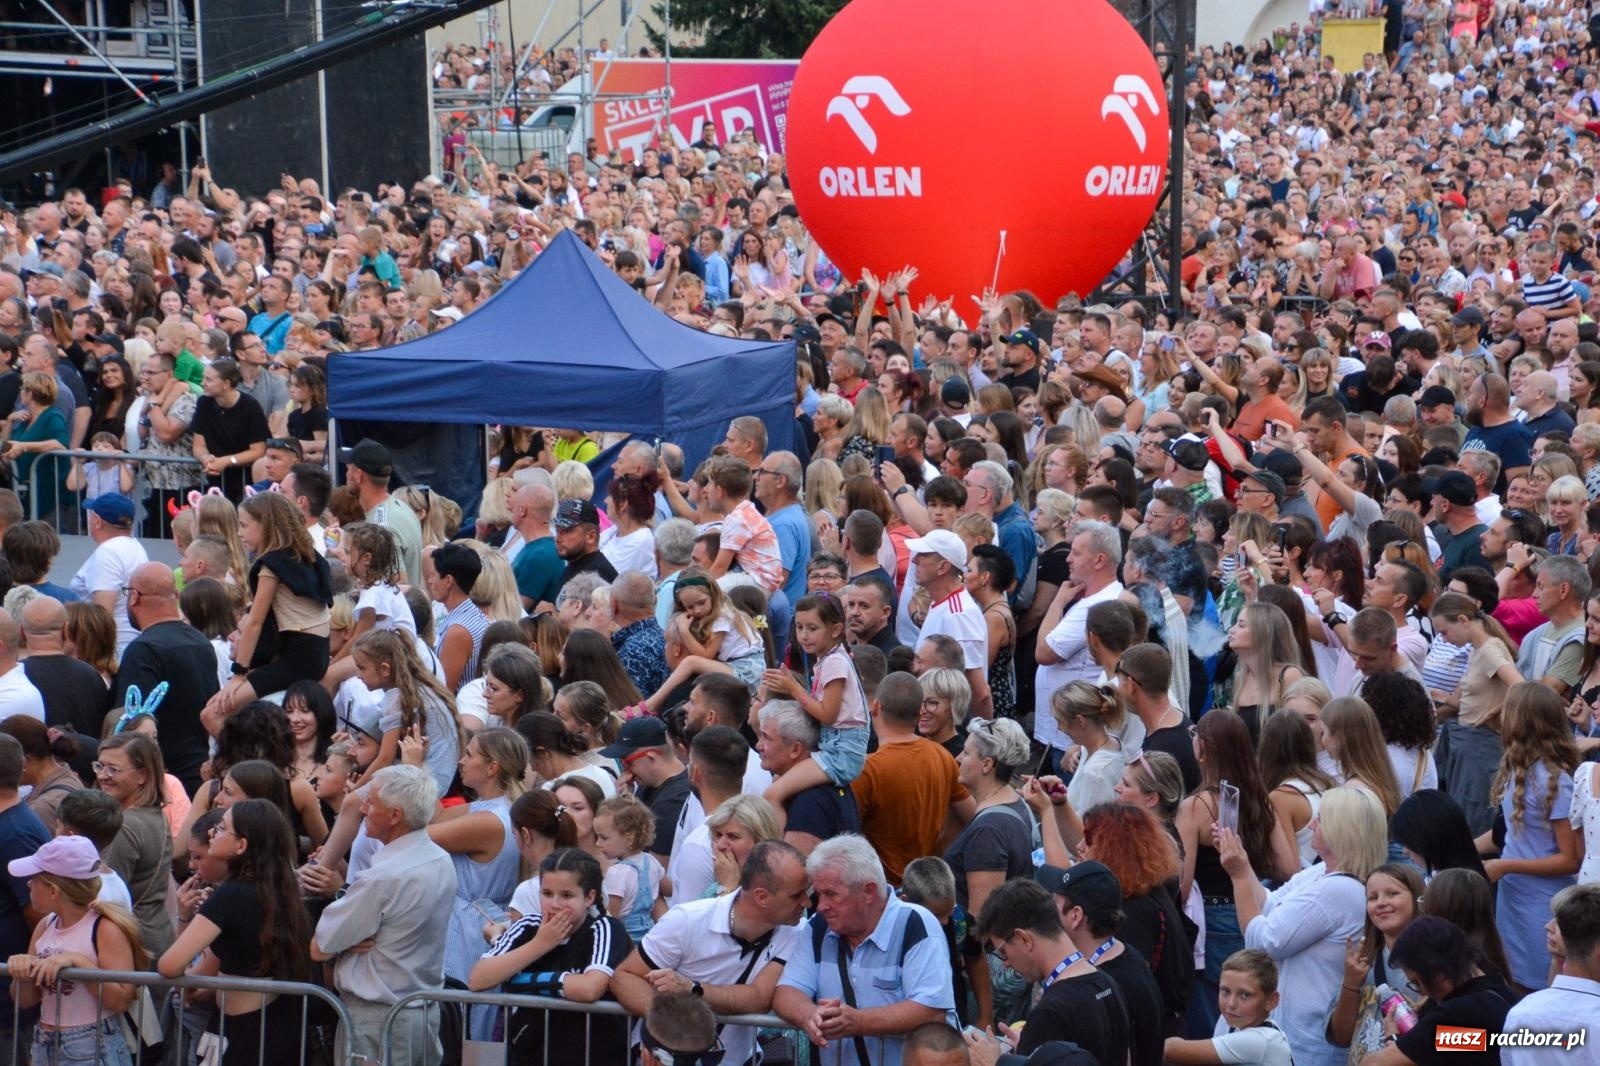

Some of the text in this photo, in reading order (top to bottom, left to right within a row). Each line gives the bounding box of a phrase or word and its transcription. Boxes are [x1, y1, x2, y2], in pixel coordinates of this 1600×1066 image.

[604, 85, 676, 123] SKLEP
[819, 166, 922, 197] ORLEN
[1085, 165, 1161, 197] ORLEN
